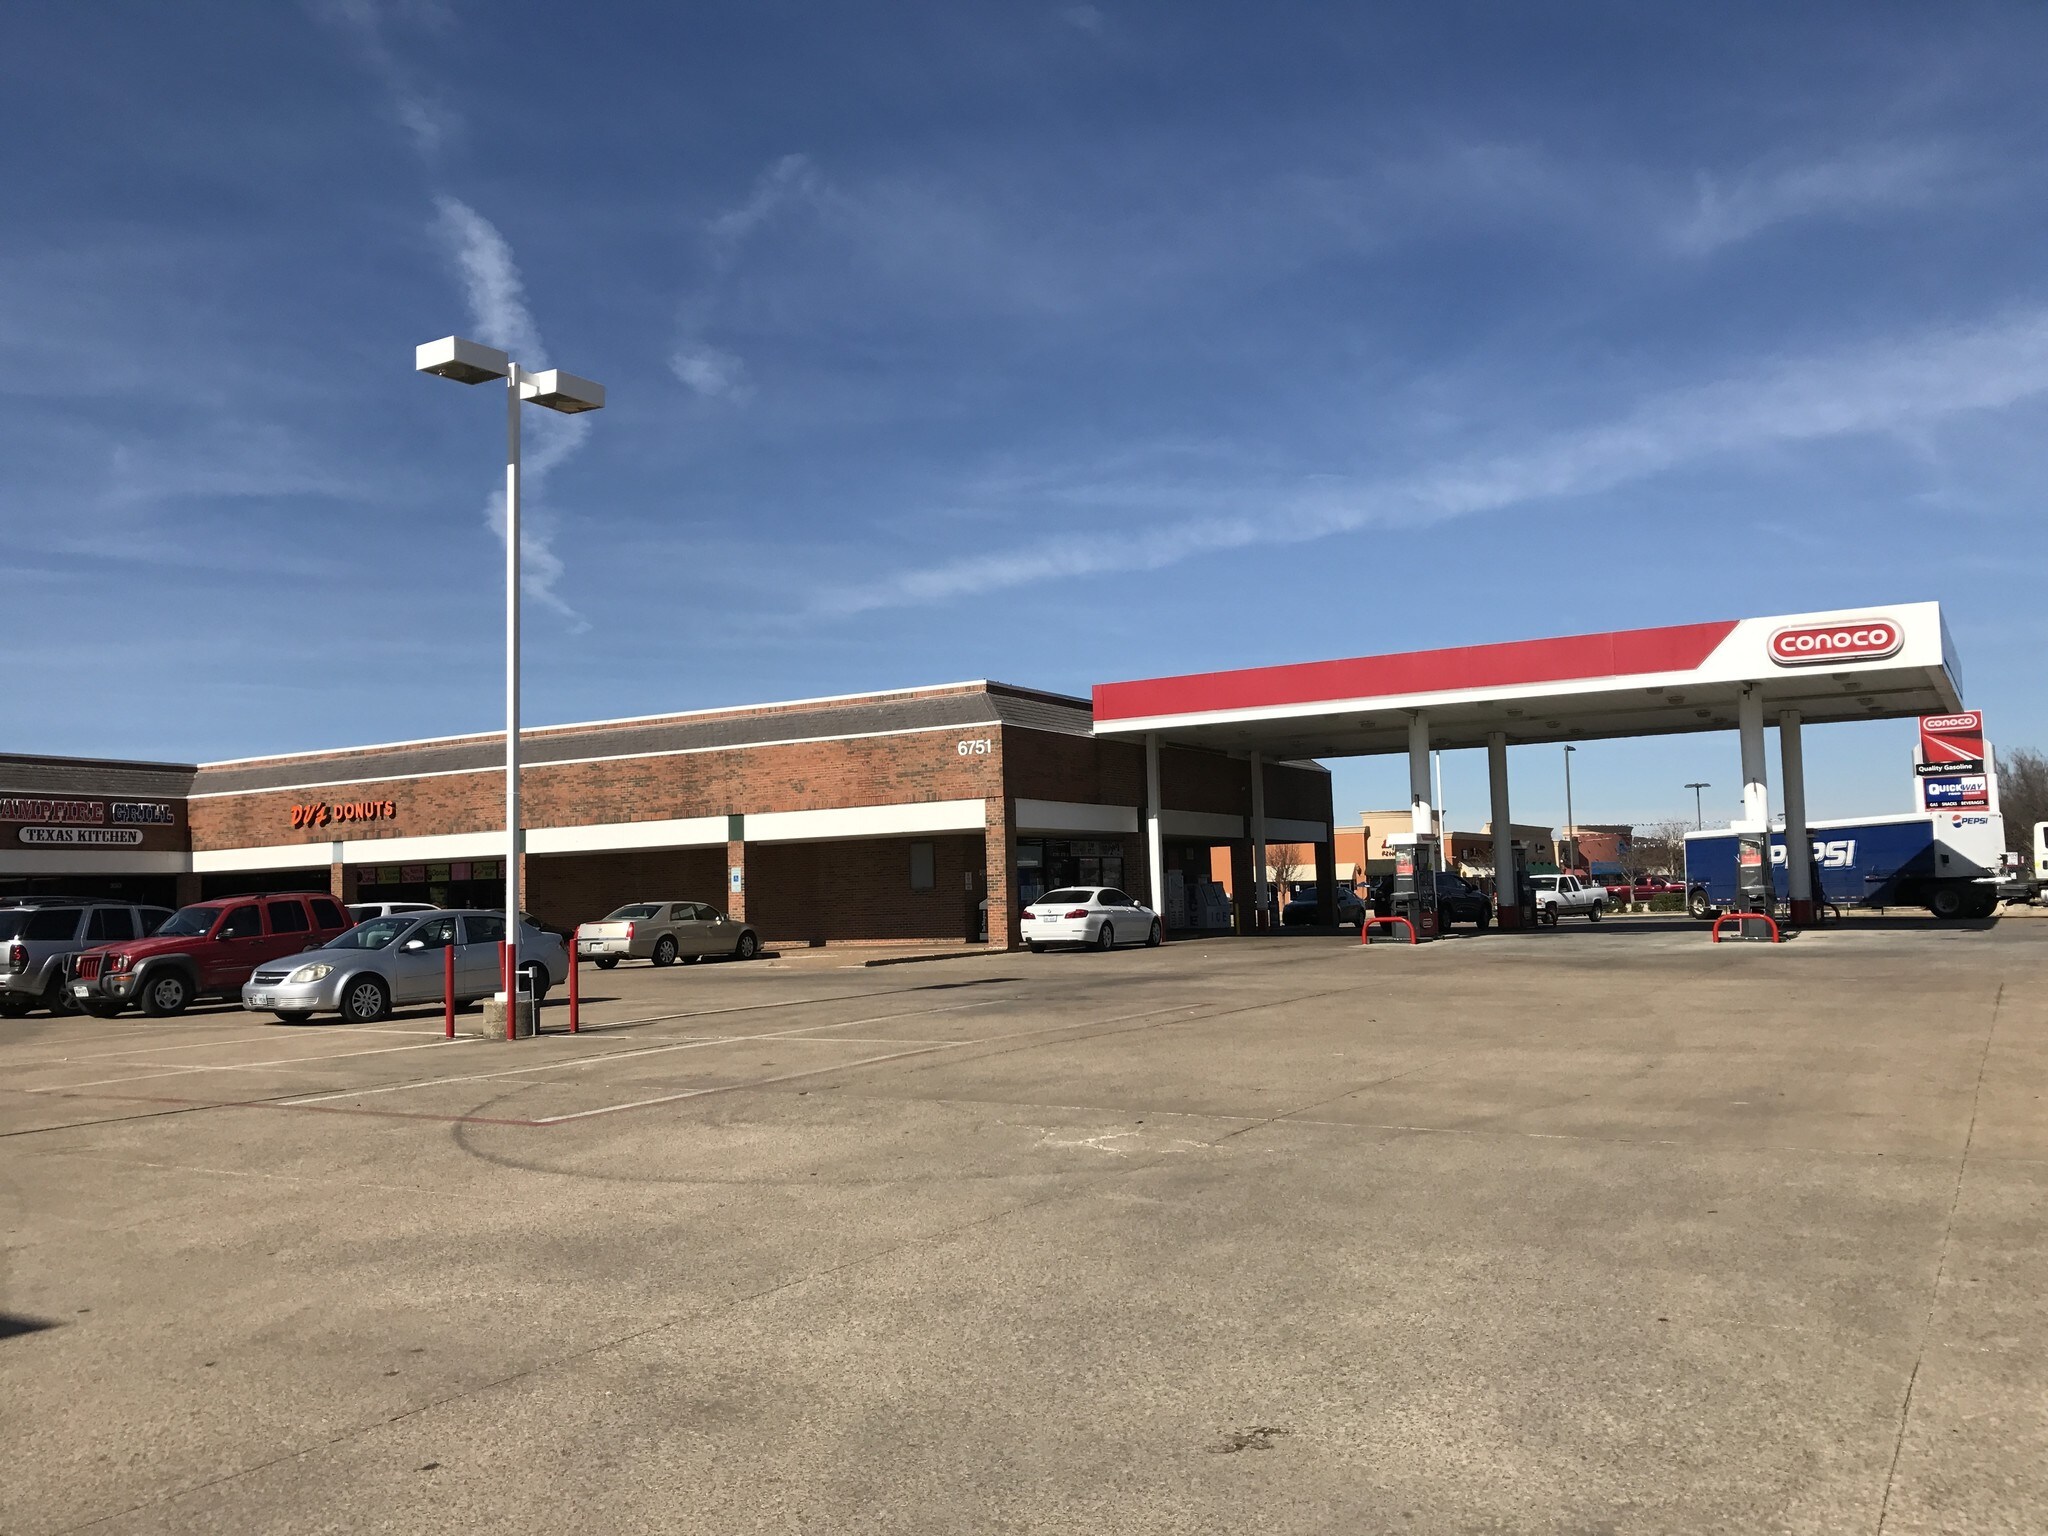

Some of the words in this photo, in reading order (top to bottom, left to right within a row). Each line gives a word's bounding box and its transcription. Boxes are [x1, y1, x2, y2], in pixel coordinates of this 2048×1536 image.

[957, 738, 992, 756] 6751
[0, 798, 104, 824] AMPFIRE
[111, 802, 175, 826] GRILL
[333, 800, 394, 821] DONUTS
[26, 828, 73, 842] TEXAS
[77, 830, 138, 843] KITCHEN
[1770, 840, 1856, 869] PPSI
